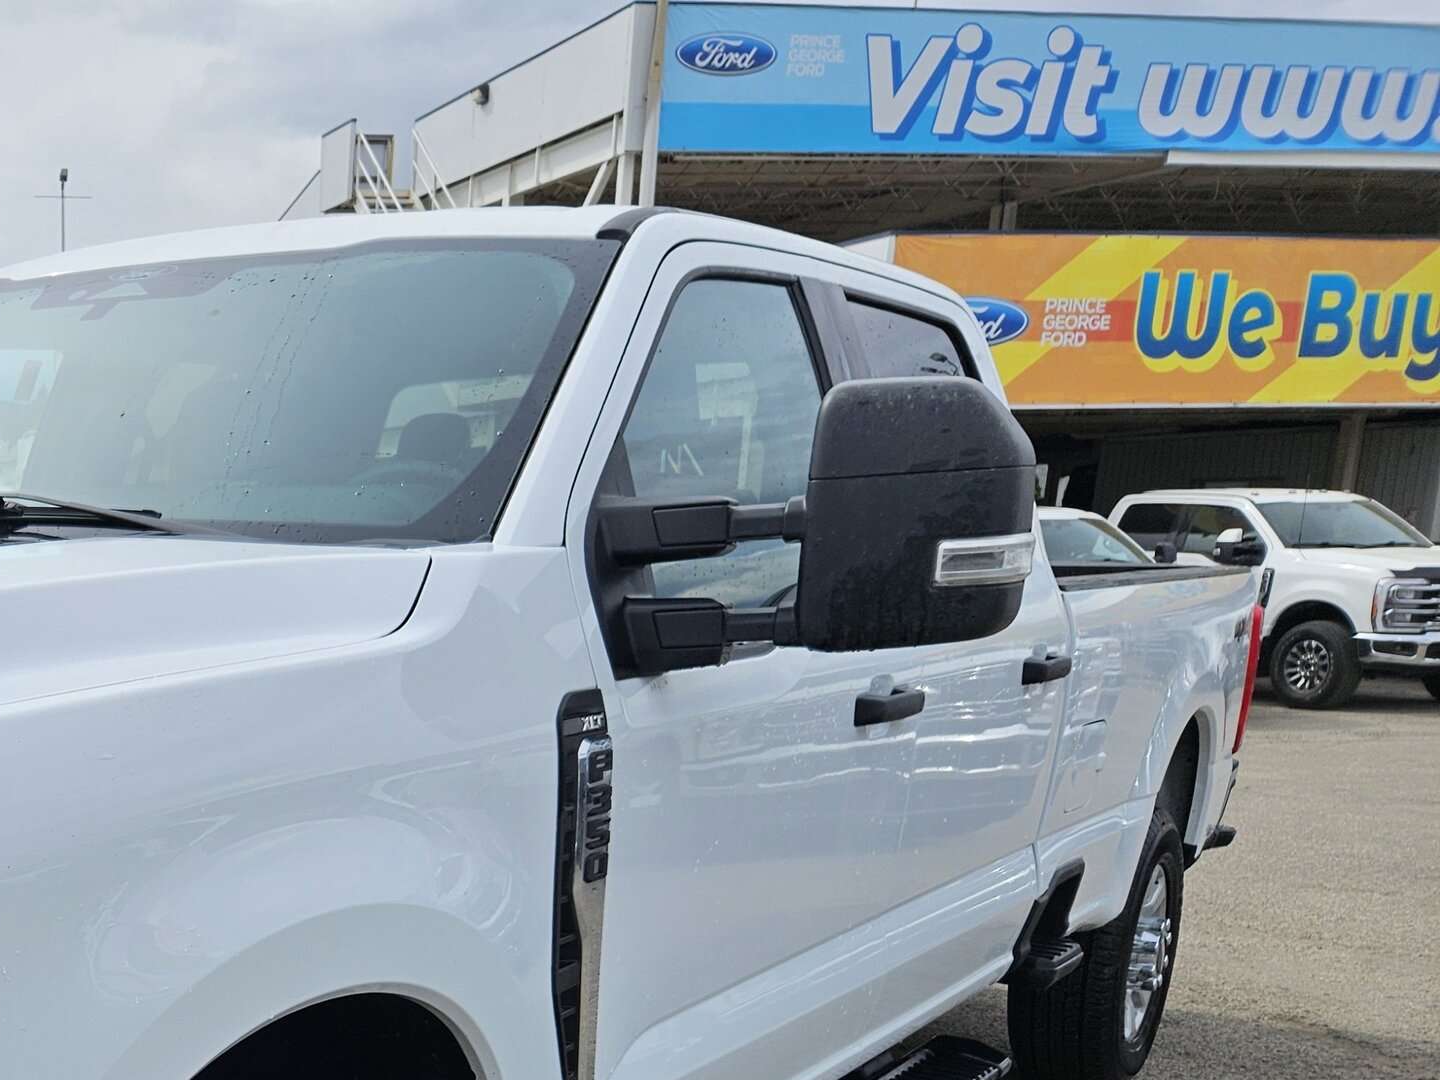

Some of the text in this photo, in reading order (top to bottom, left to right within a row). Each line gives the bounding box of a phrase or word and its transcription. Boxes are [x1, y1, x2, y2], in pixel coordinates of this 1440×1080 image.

[789, 34, 842, 48] PRINCE
[694, 37, 758, 70] Ford
[787, 48, 846, 63] GEORGE
[785, 63, 826, 77] FORD
[865, 22, 1116, 139] Visit
[1044, 297, 1107, 314] PRINCE
[1042, 313, 1112, 331] GEORGE
[1133, 268, 1440, 383] We Buy
[1040, 330, 1087, 348] FORD
